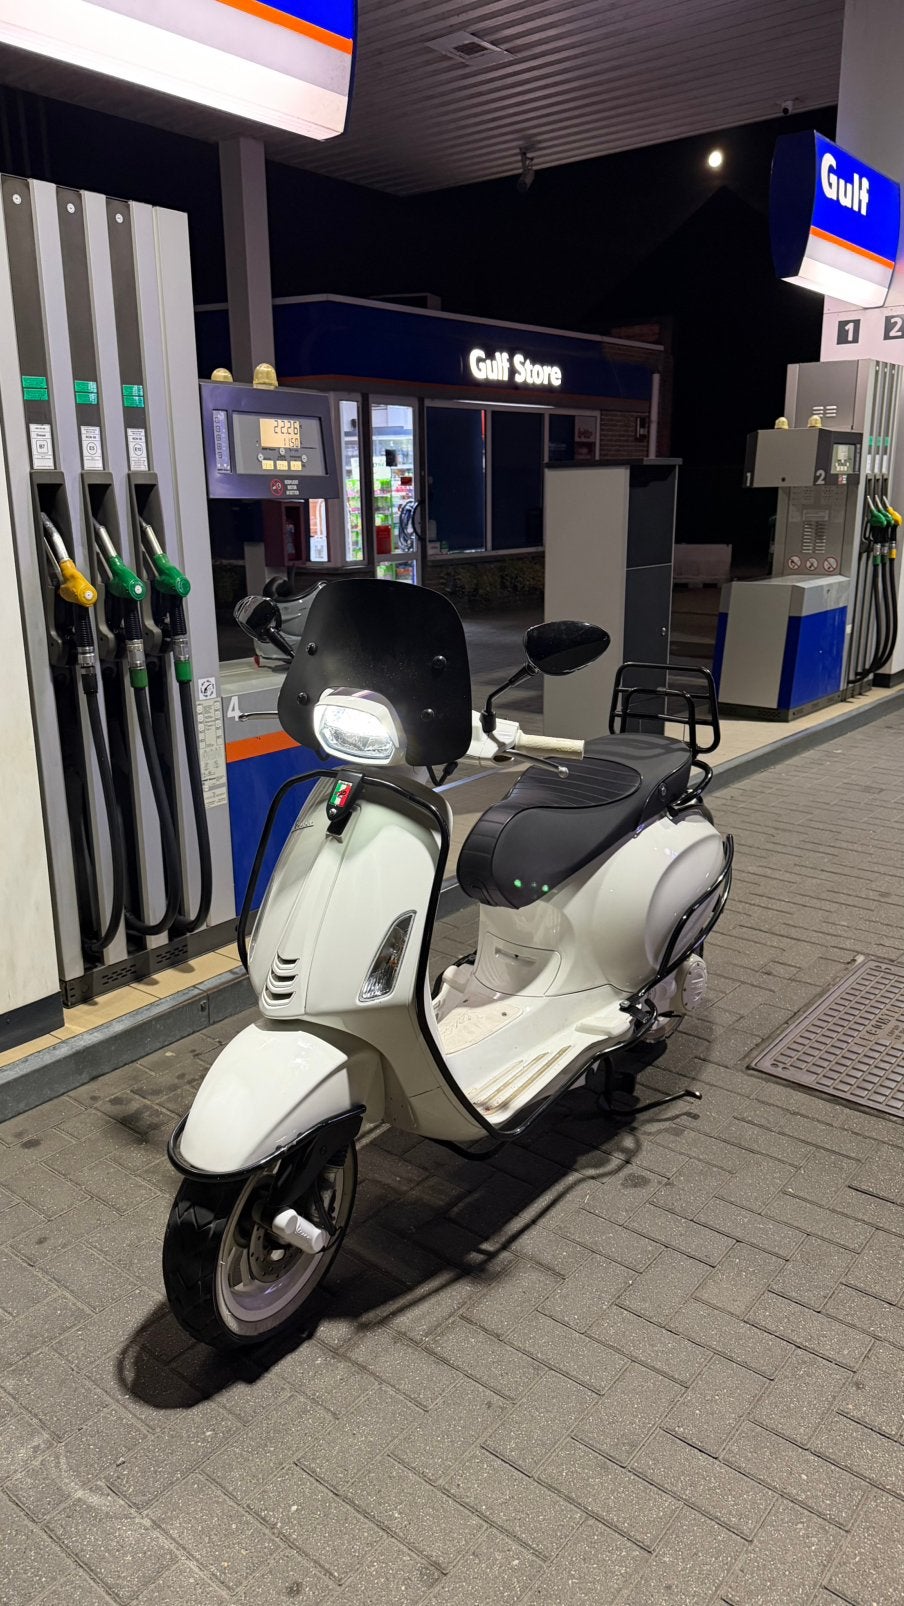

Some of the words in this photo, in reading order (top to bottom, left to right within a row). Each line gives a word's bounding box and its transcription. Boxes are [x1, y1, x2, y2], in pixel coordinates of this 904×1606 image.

[821, 152, 870, 216] Gulf
[844, 322, 855, 341] 1
[889, 317, 903, 337] 2
[469, 348, 510, 381] Gulf
[513, 353, 562, 386] Store
[746, 472, 752, 487] 1
[815, 469, 826, 485] 2
[227, 695, 241, 722] 4
